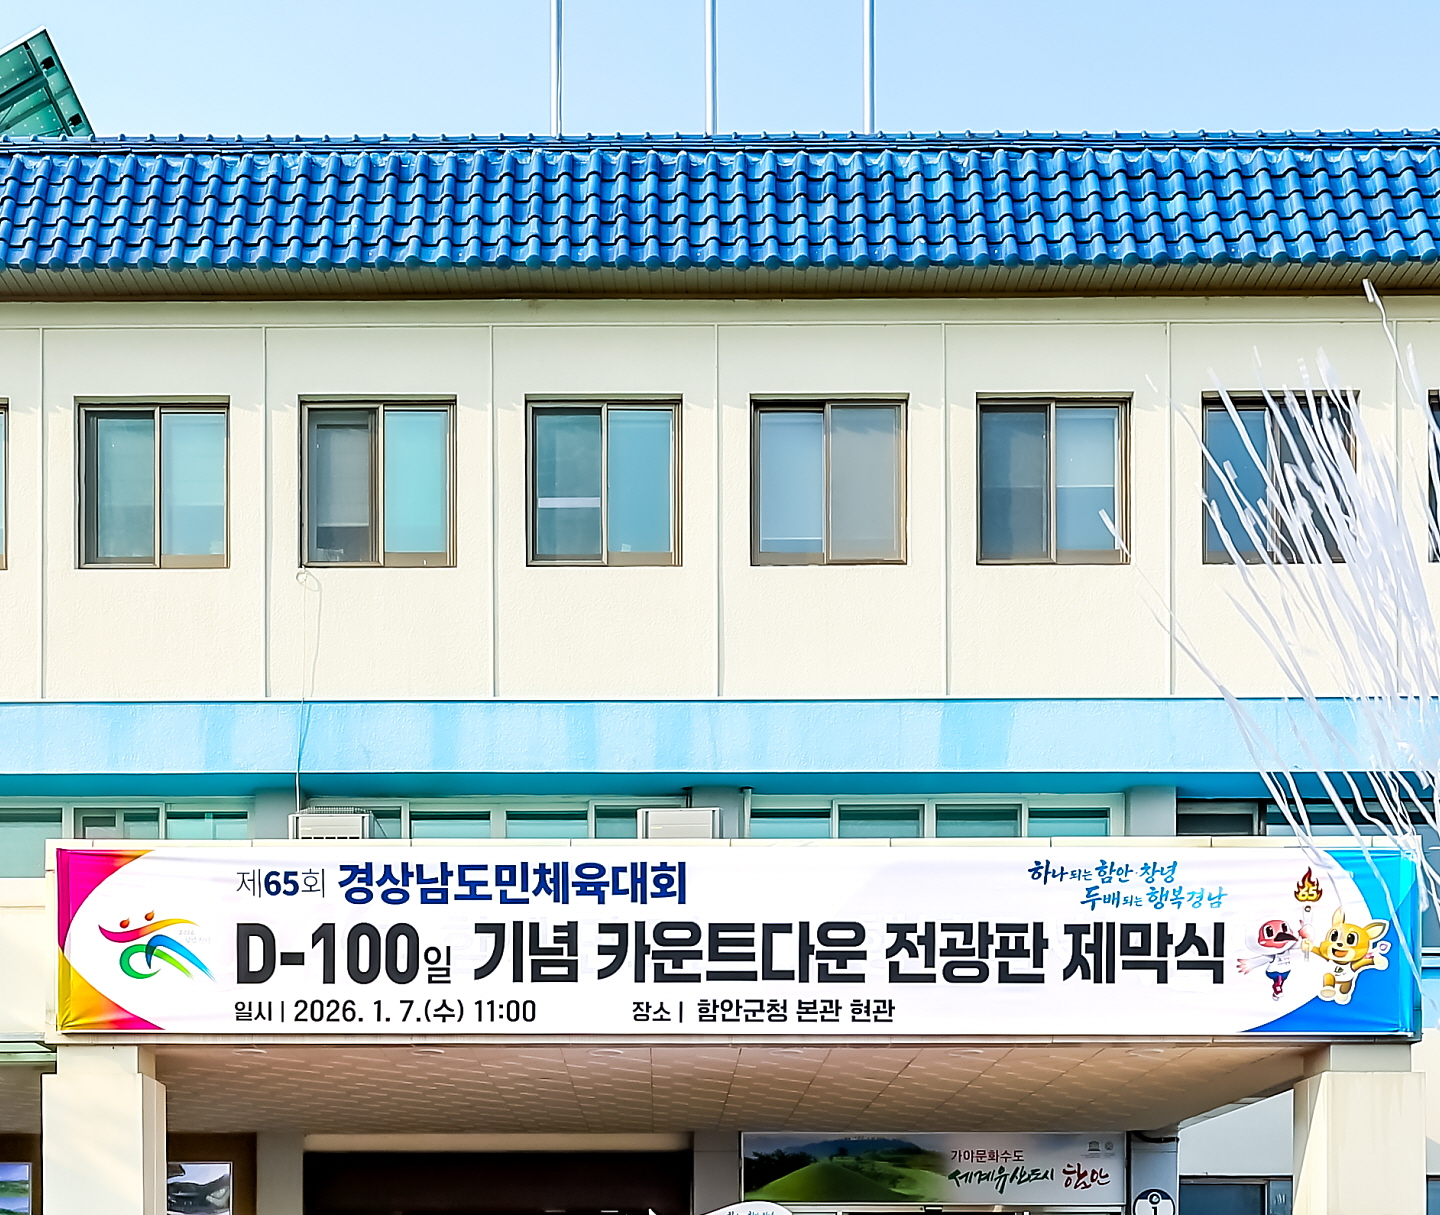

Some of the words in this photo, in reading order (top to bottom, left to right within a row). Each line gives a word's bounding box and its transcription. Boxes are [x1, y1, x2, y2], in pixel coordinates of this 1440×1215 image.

[236, 868, 326, 898] 제65회
[337, 861, 687, 906] 경상남도민체육대회
[1298, 885, 1318, 900] 65
[473, 920, 580, 984] 기념
[597, 920, 868, 984] 카운트다운
[885, 921, 1049, 984] 전광판
[1062, 921, 1227, 985] 제막식
[234, 1001, 272, 1022] 일시
[293, 999, 364, 1023] 2026.
[373, 999, 391, 1023] 1.
[399, 999, 464, 1023] 7.(수)
[474, 999, 536, 1023] 11:00
[632, 1001, 672, 1022] 장소
[697, 998, 788, 1023] 함안군청
[796, 999, 842, 1023] 본관
[850, 999, 896, 1023] 현관
[950, 1149, 1025, 1163] 가야문화수도
[948, 1165, 1054, 1194] 세계유산도시
[1062, 1163, 1111, 1190] 함안
